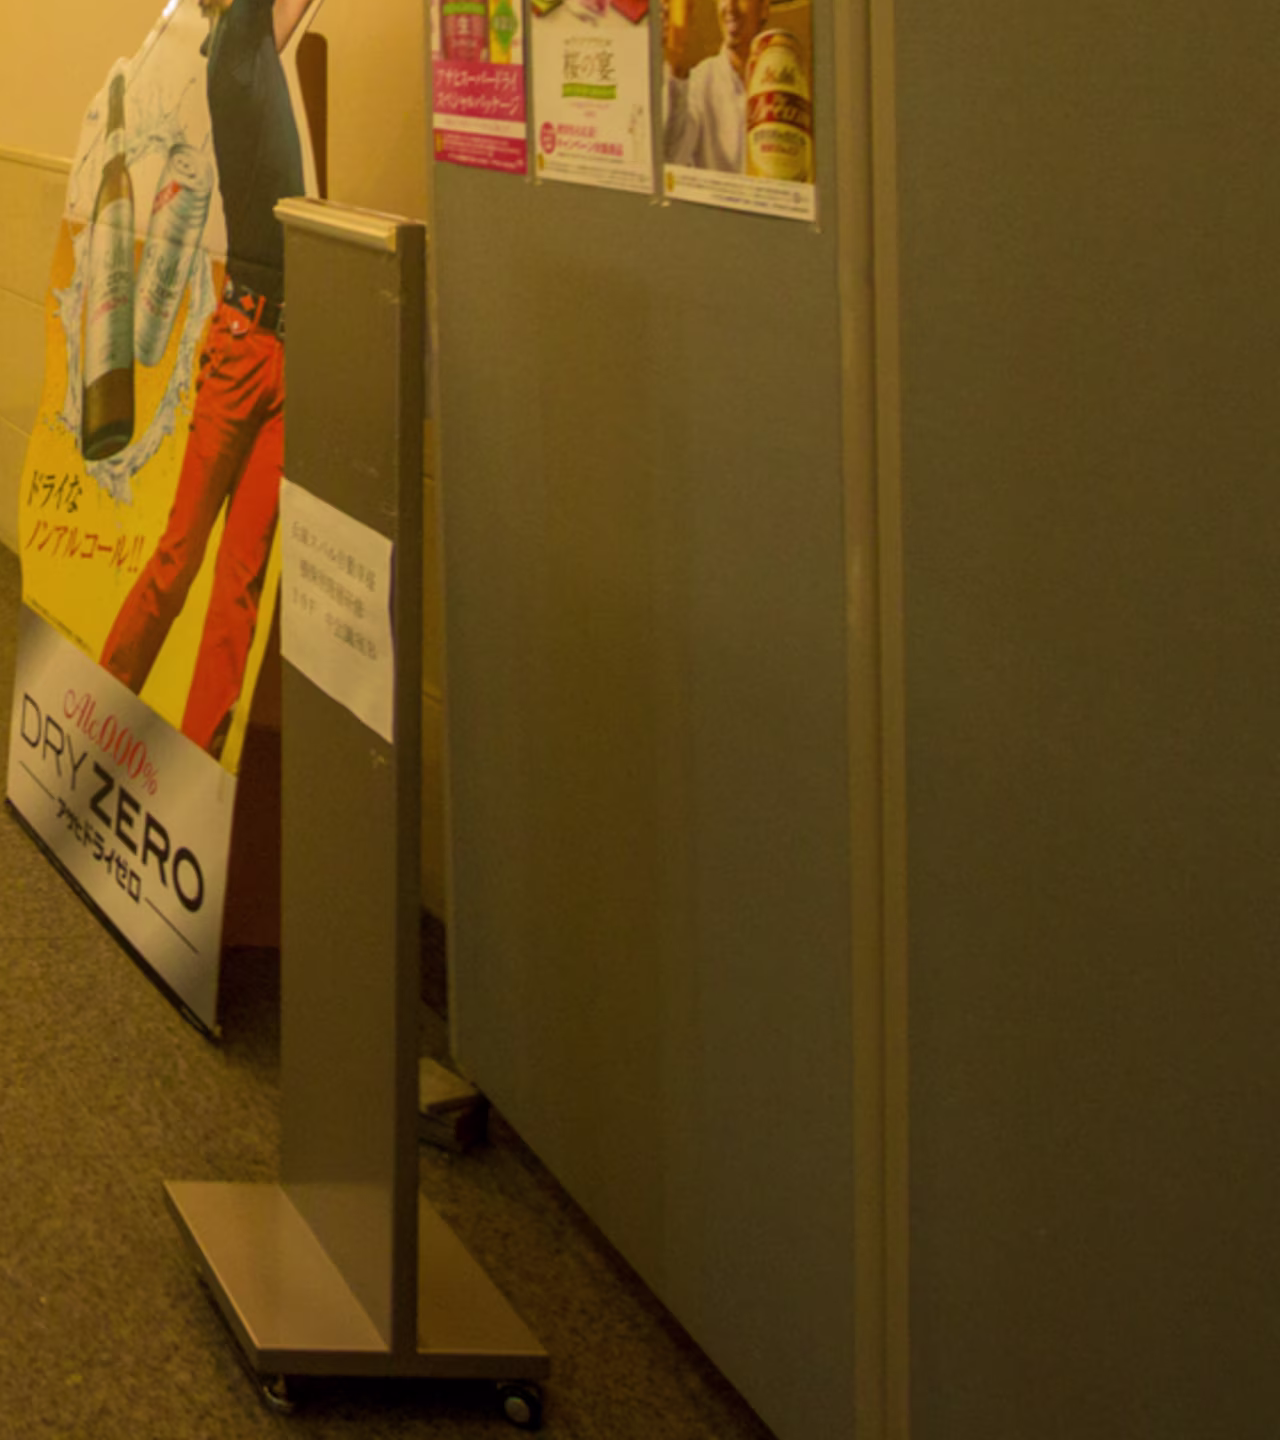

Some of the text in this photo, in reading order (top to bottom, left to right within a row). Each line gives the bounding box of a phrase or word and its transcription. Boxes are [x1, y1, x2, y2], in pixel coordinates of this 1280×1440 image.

[27, 470, 83, 513] ドライな
[20, 692, 88, 791] DRY
[89, 761, 205, 913] ZERO
[55, 797, 142, 905] アサヒドライゼロ
